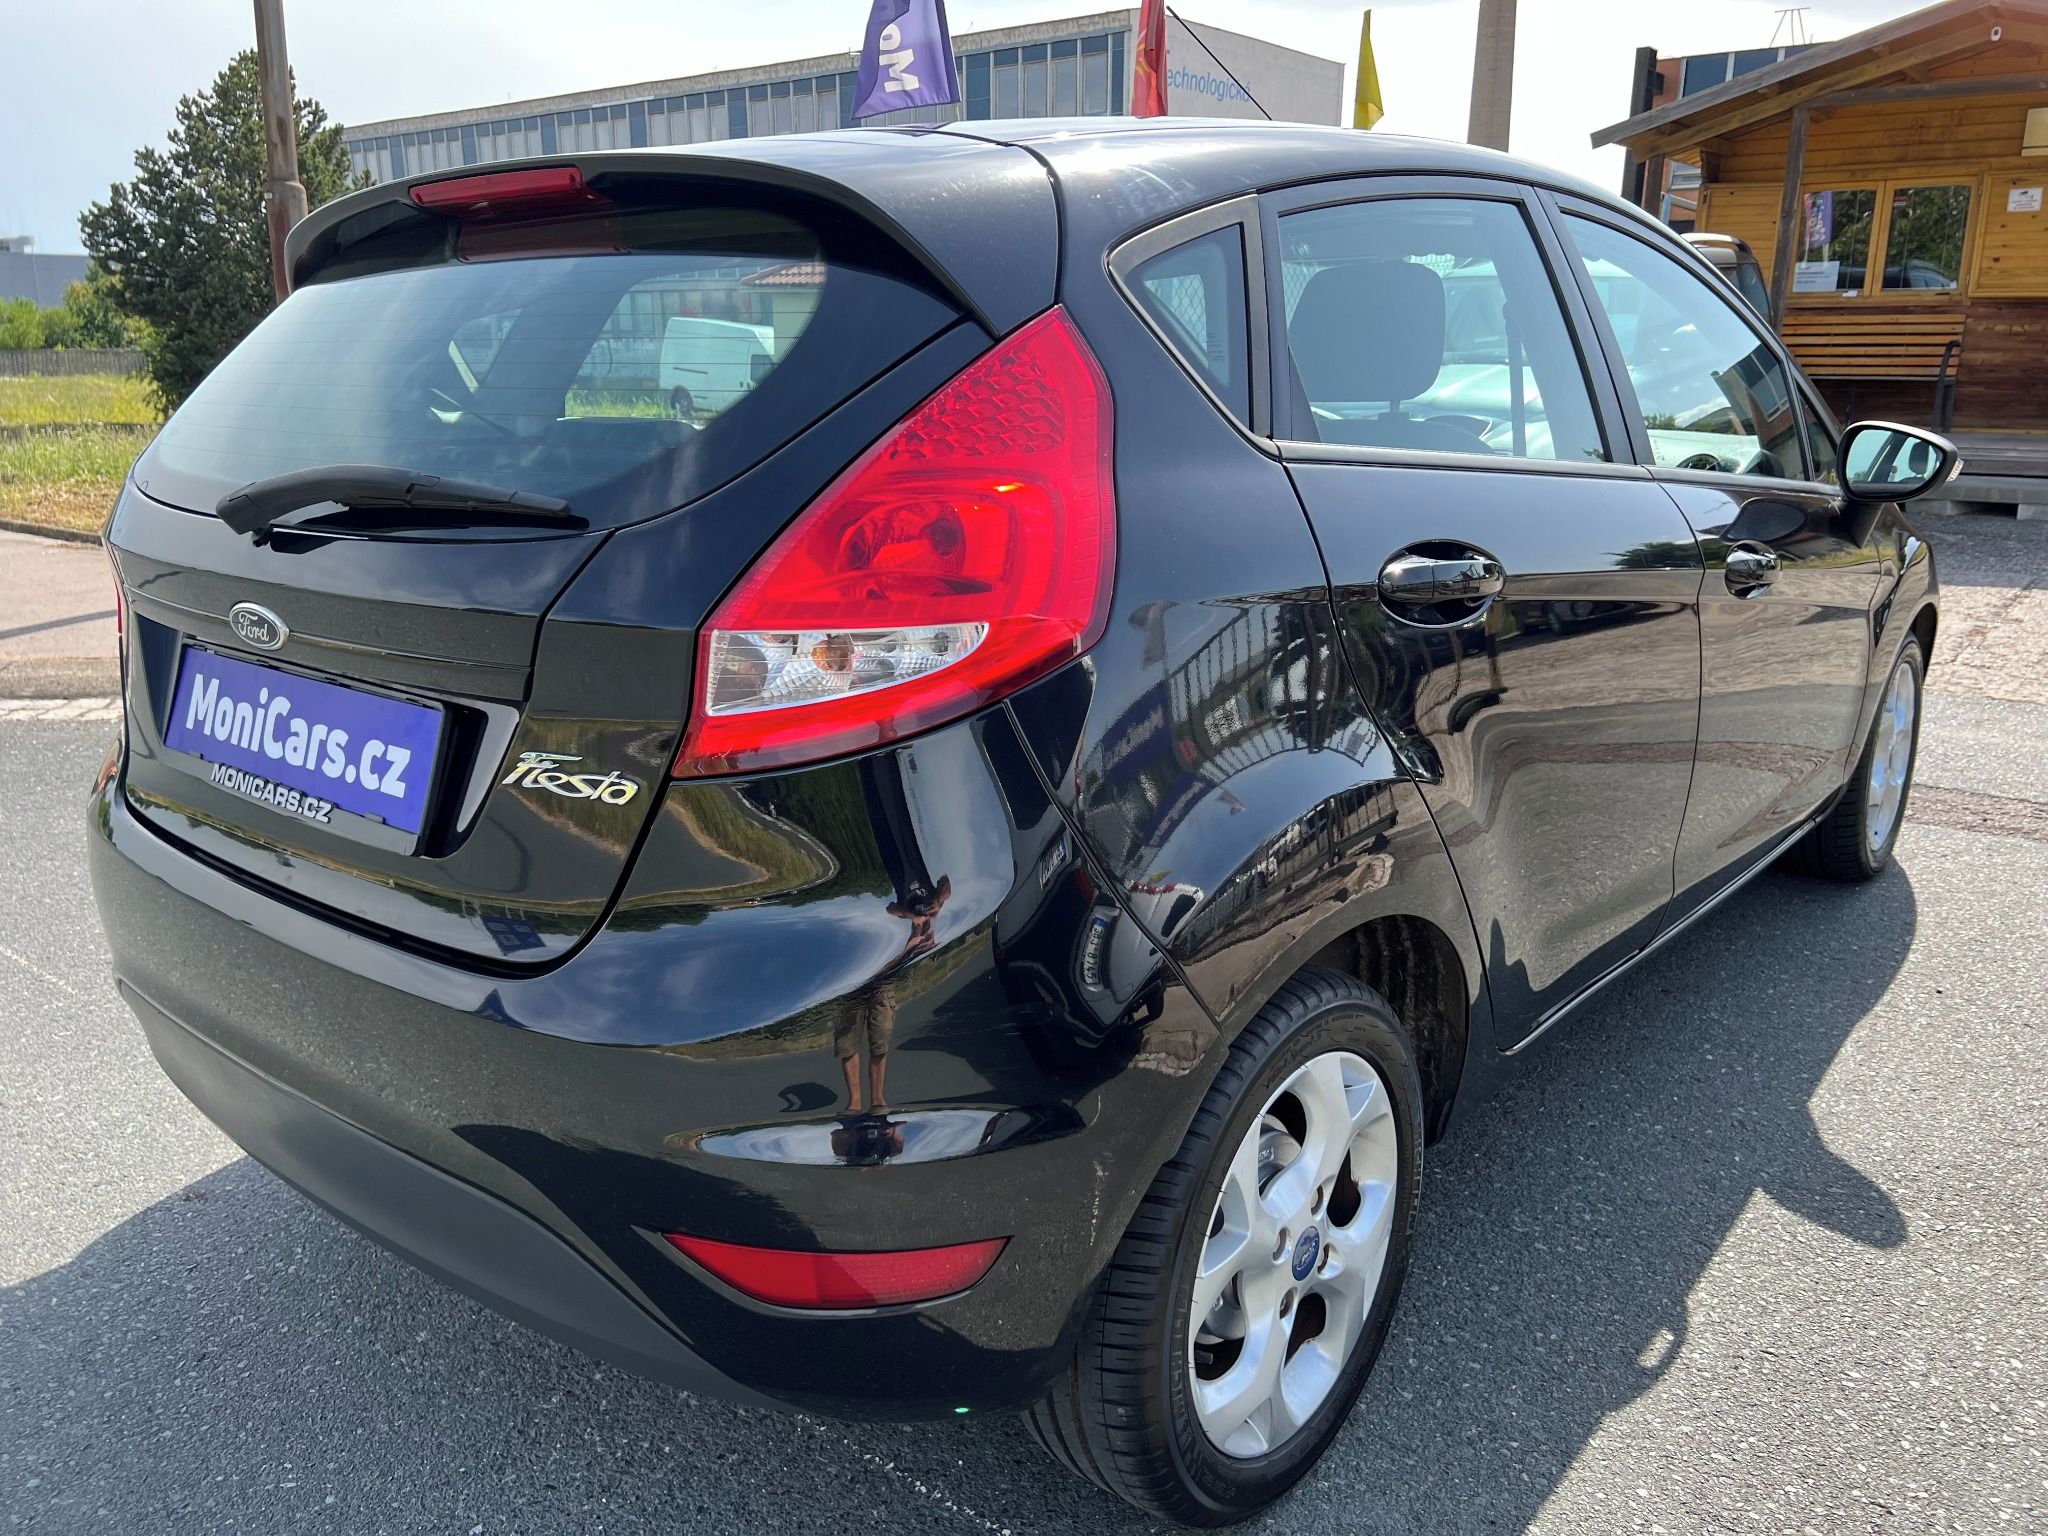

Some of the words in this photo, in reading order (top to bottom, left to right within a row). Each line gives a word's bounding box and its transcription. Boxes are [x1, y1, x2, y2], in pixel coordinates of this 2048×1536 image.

[238, 611, 270, 642] Ford
[186, 673, 411, 799] MoniCars.cz
[210, 763, 332, 823] MONICARS.CZ
[501, 751, 639, 806] Fiesta
